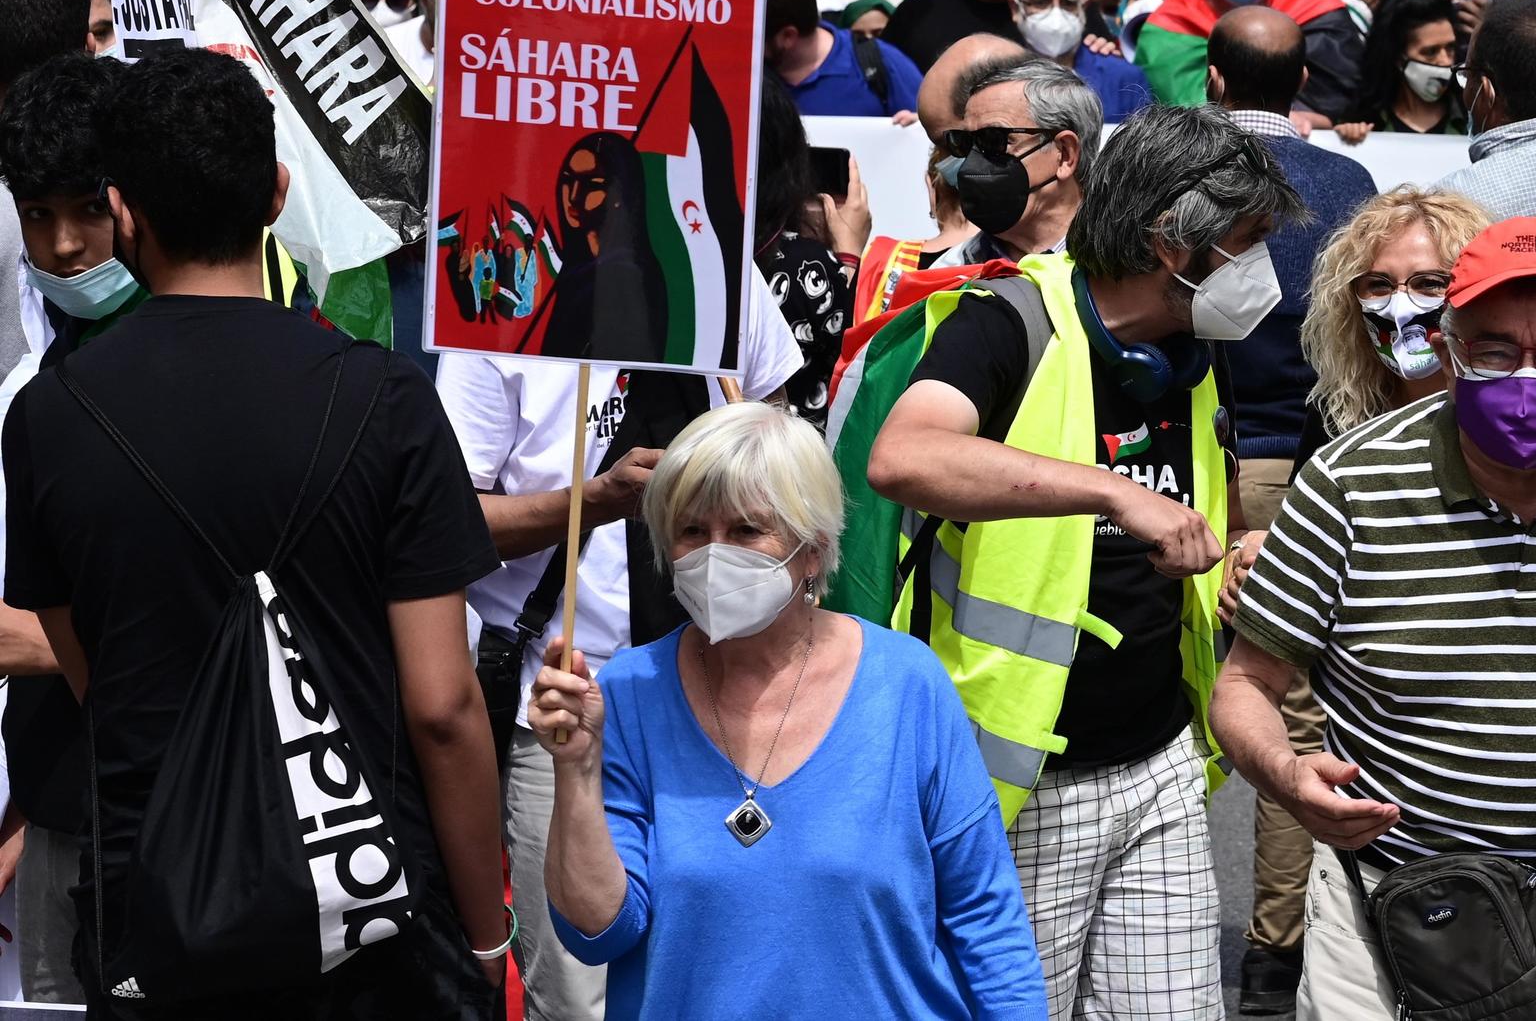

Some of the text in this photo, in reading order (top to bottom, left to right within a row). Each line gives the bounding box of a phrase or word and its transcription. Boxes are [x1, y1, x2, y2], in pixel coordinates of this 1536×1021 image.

[459, 28, 639, 82] SÁHARA
[460, 73, 638, 132] LIBRE
[1427, 909, 1452, 923] dustin
[111, 988, 146, 998] adidas
